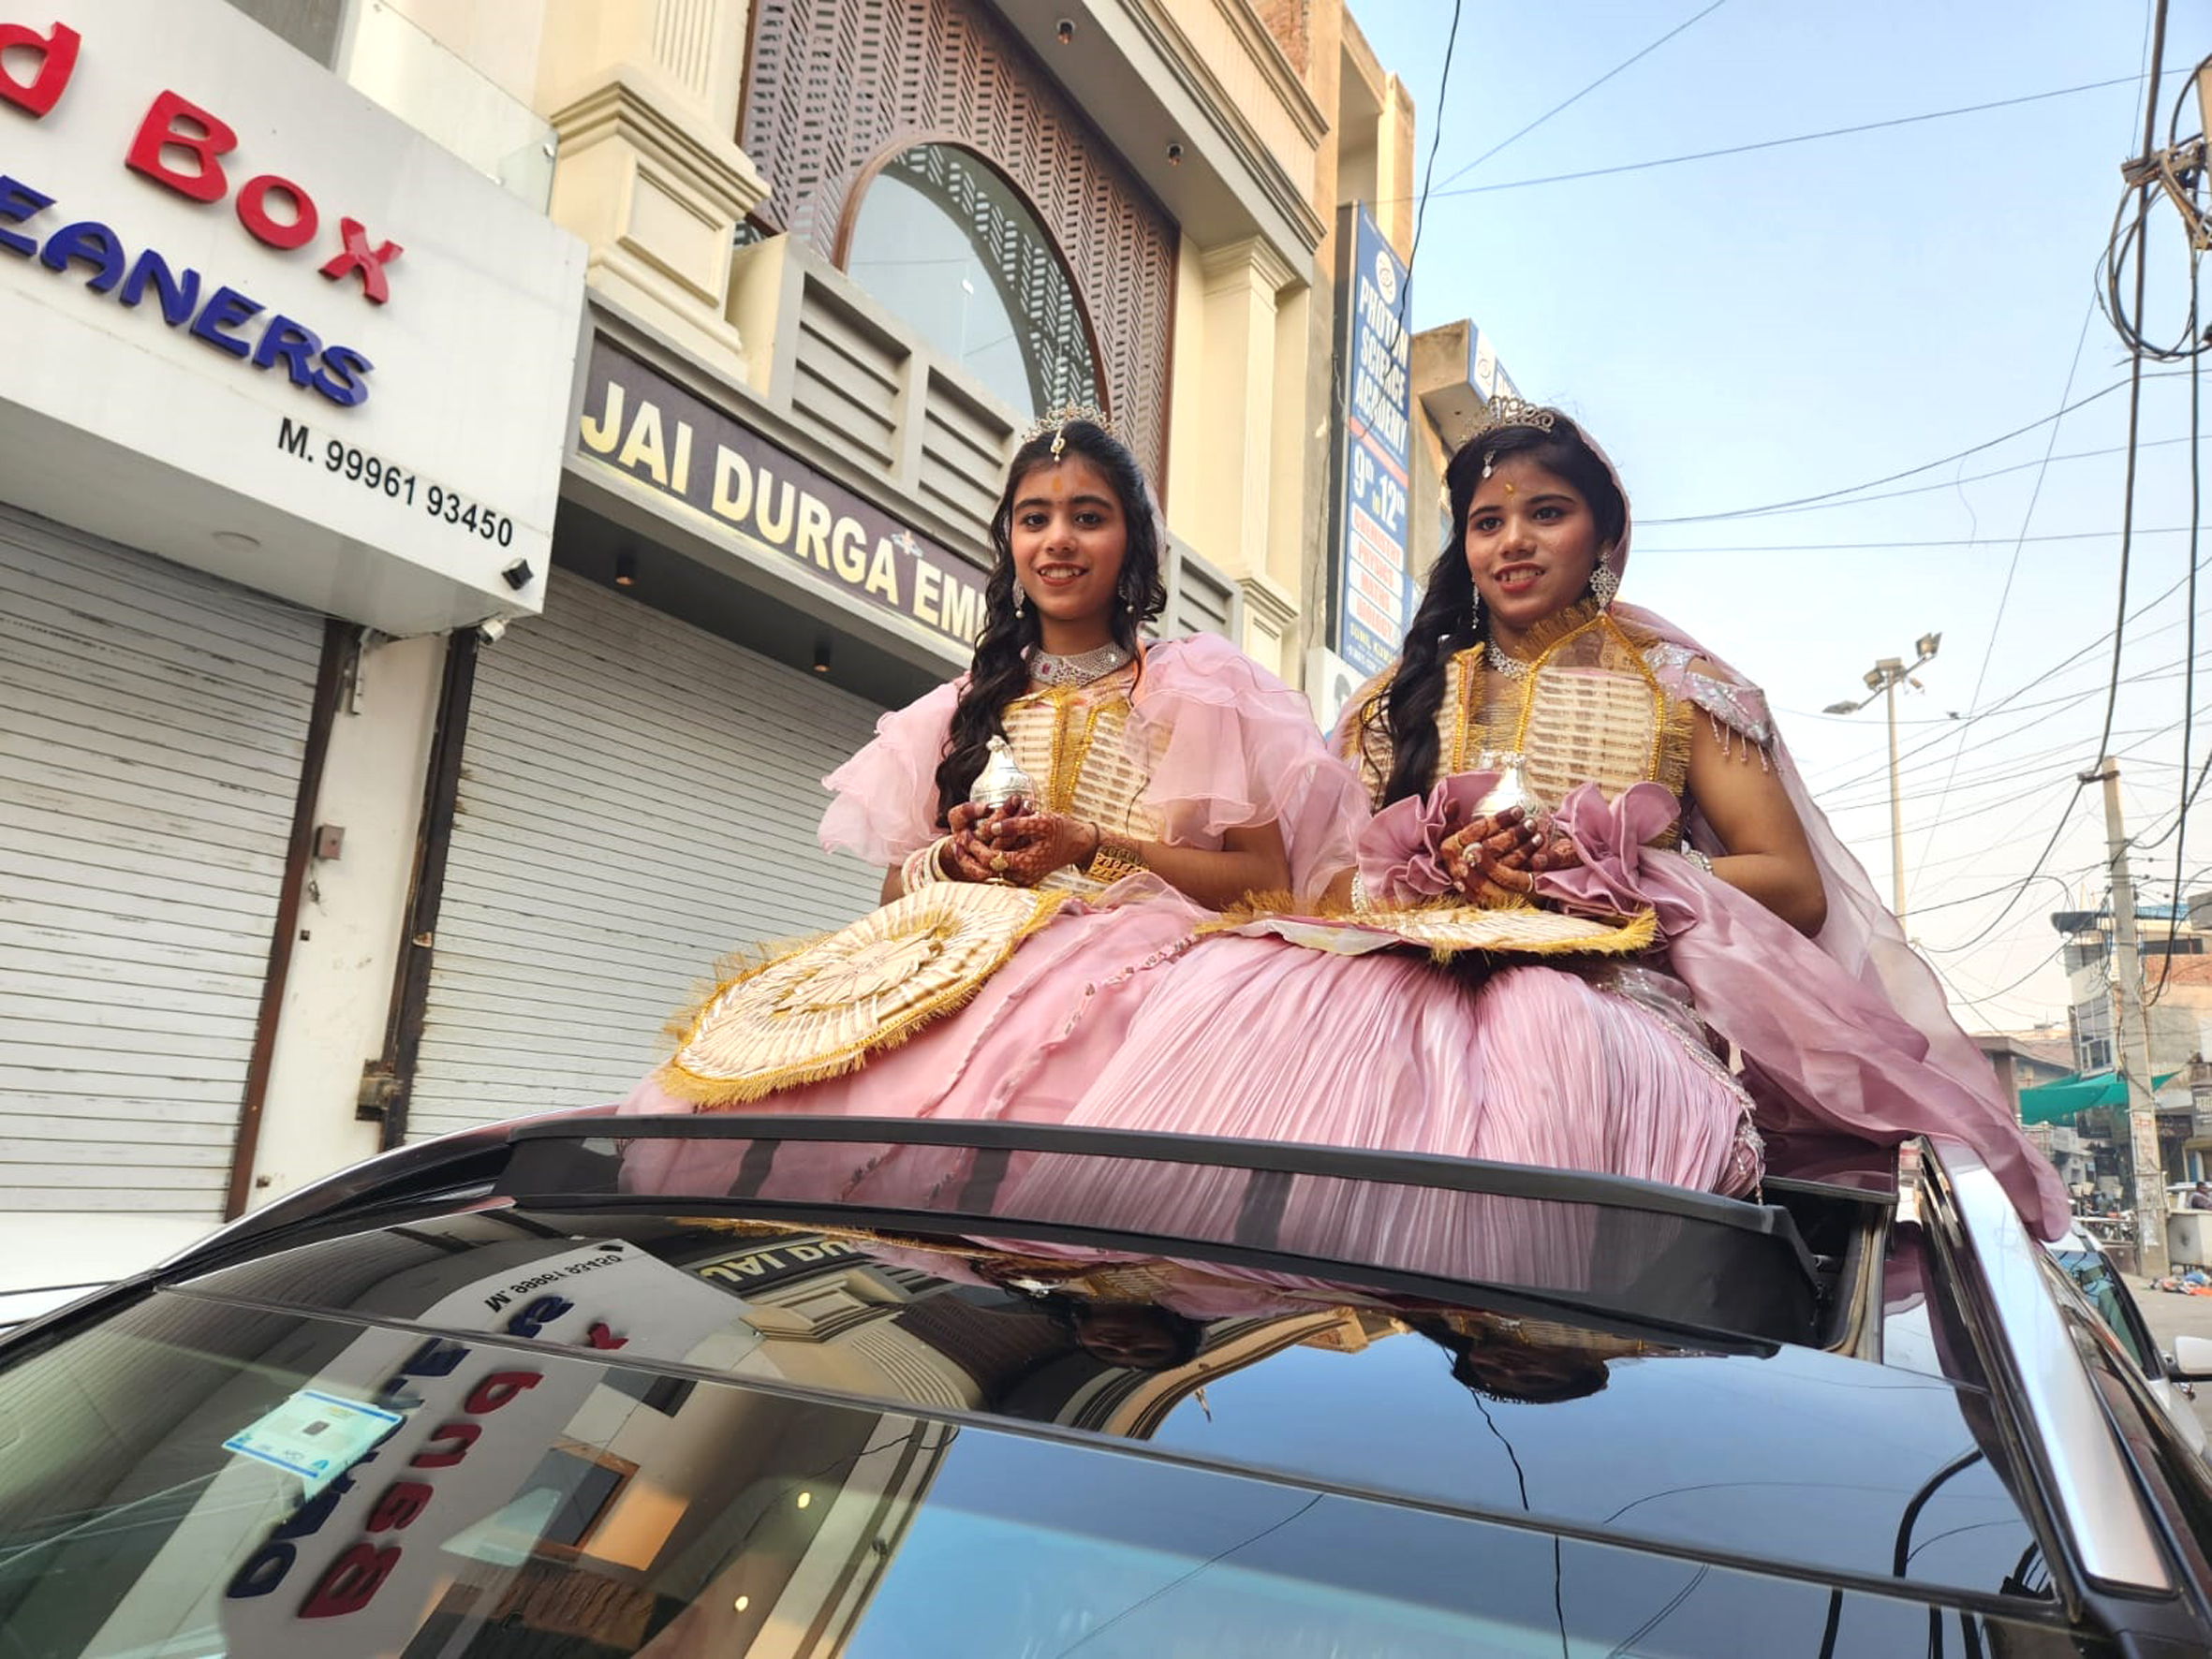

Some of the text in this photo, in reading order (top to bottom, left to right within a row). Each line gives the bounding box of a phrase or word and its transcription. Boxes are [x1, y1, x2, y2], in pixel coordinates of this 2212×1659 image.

[326, 440, 415, 506] 99961
[427, 485, 513, 548] 93450
[581, 381, 693, 495] JAI
[712, 444, 899, 606] DURGA
